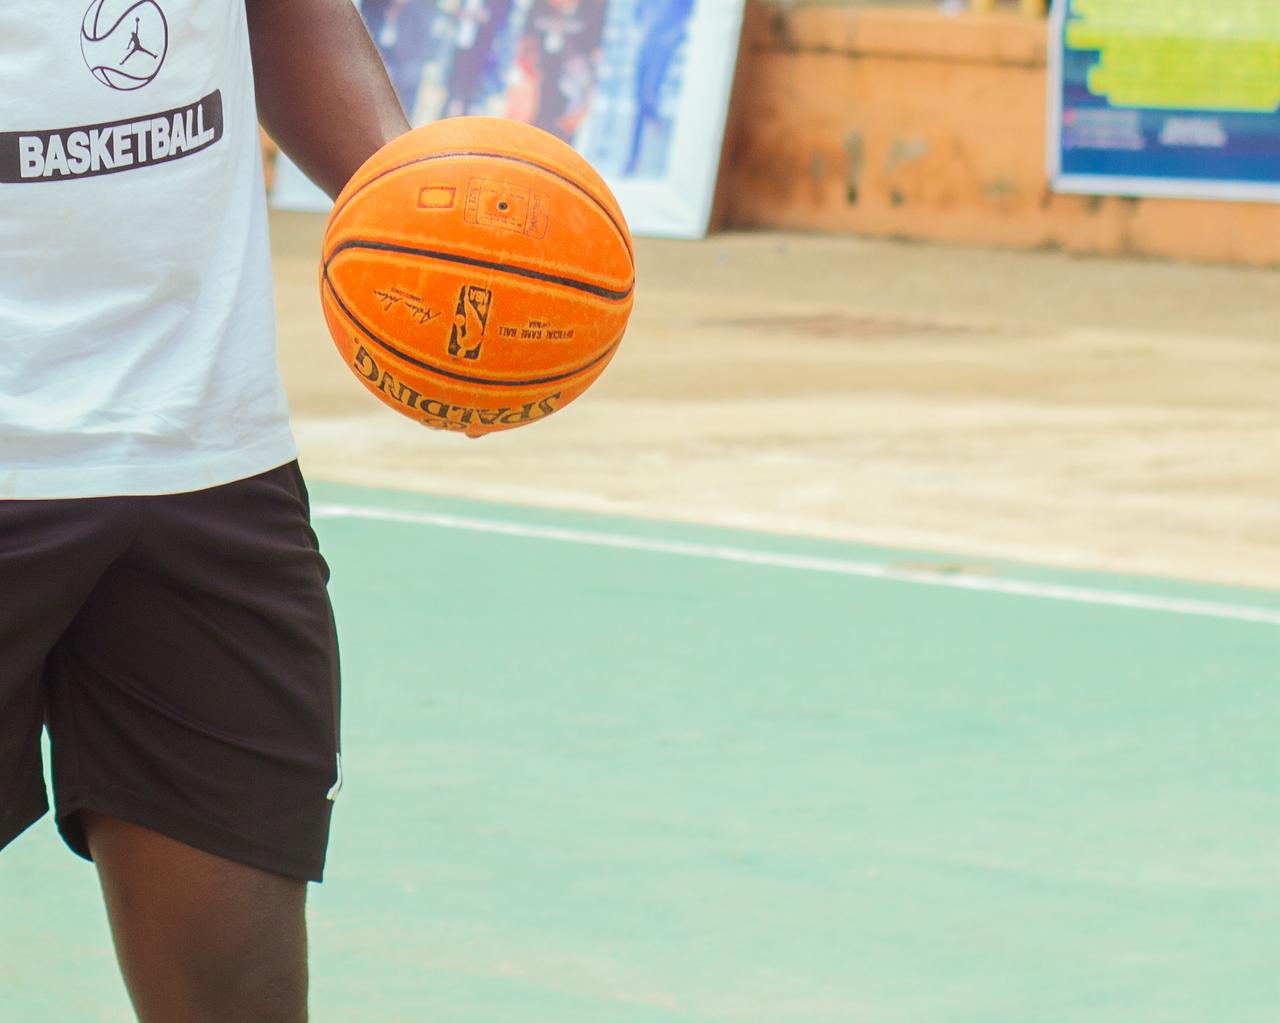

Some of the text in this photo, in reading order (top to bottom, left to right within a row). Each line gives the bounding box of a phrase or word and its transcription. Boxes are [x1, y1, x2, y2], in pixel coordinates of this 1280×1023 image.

[19, 103, 215, 178] BASKETBALL
[470, 288, 489, 305] NBA
[499, 326, 574, 340] OFFICIAL GAME BALL
[354, 344, 560, 425] SPALDING
